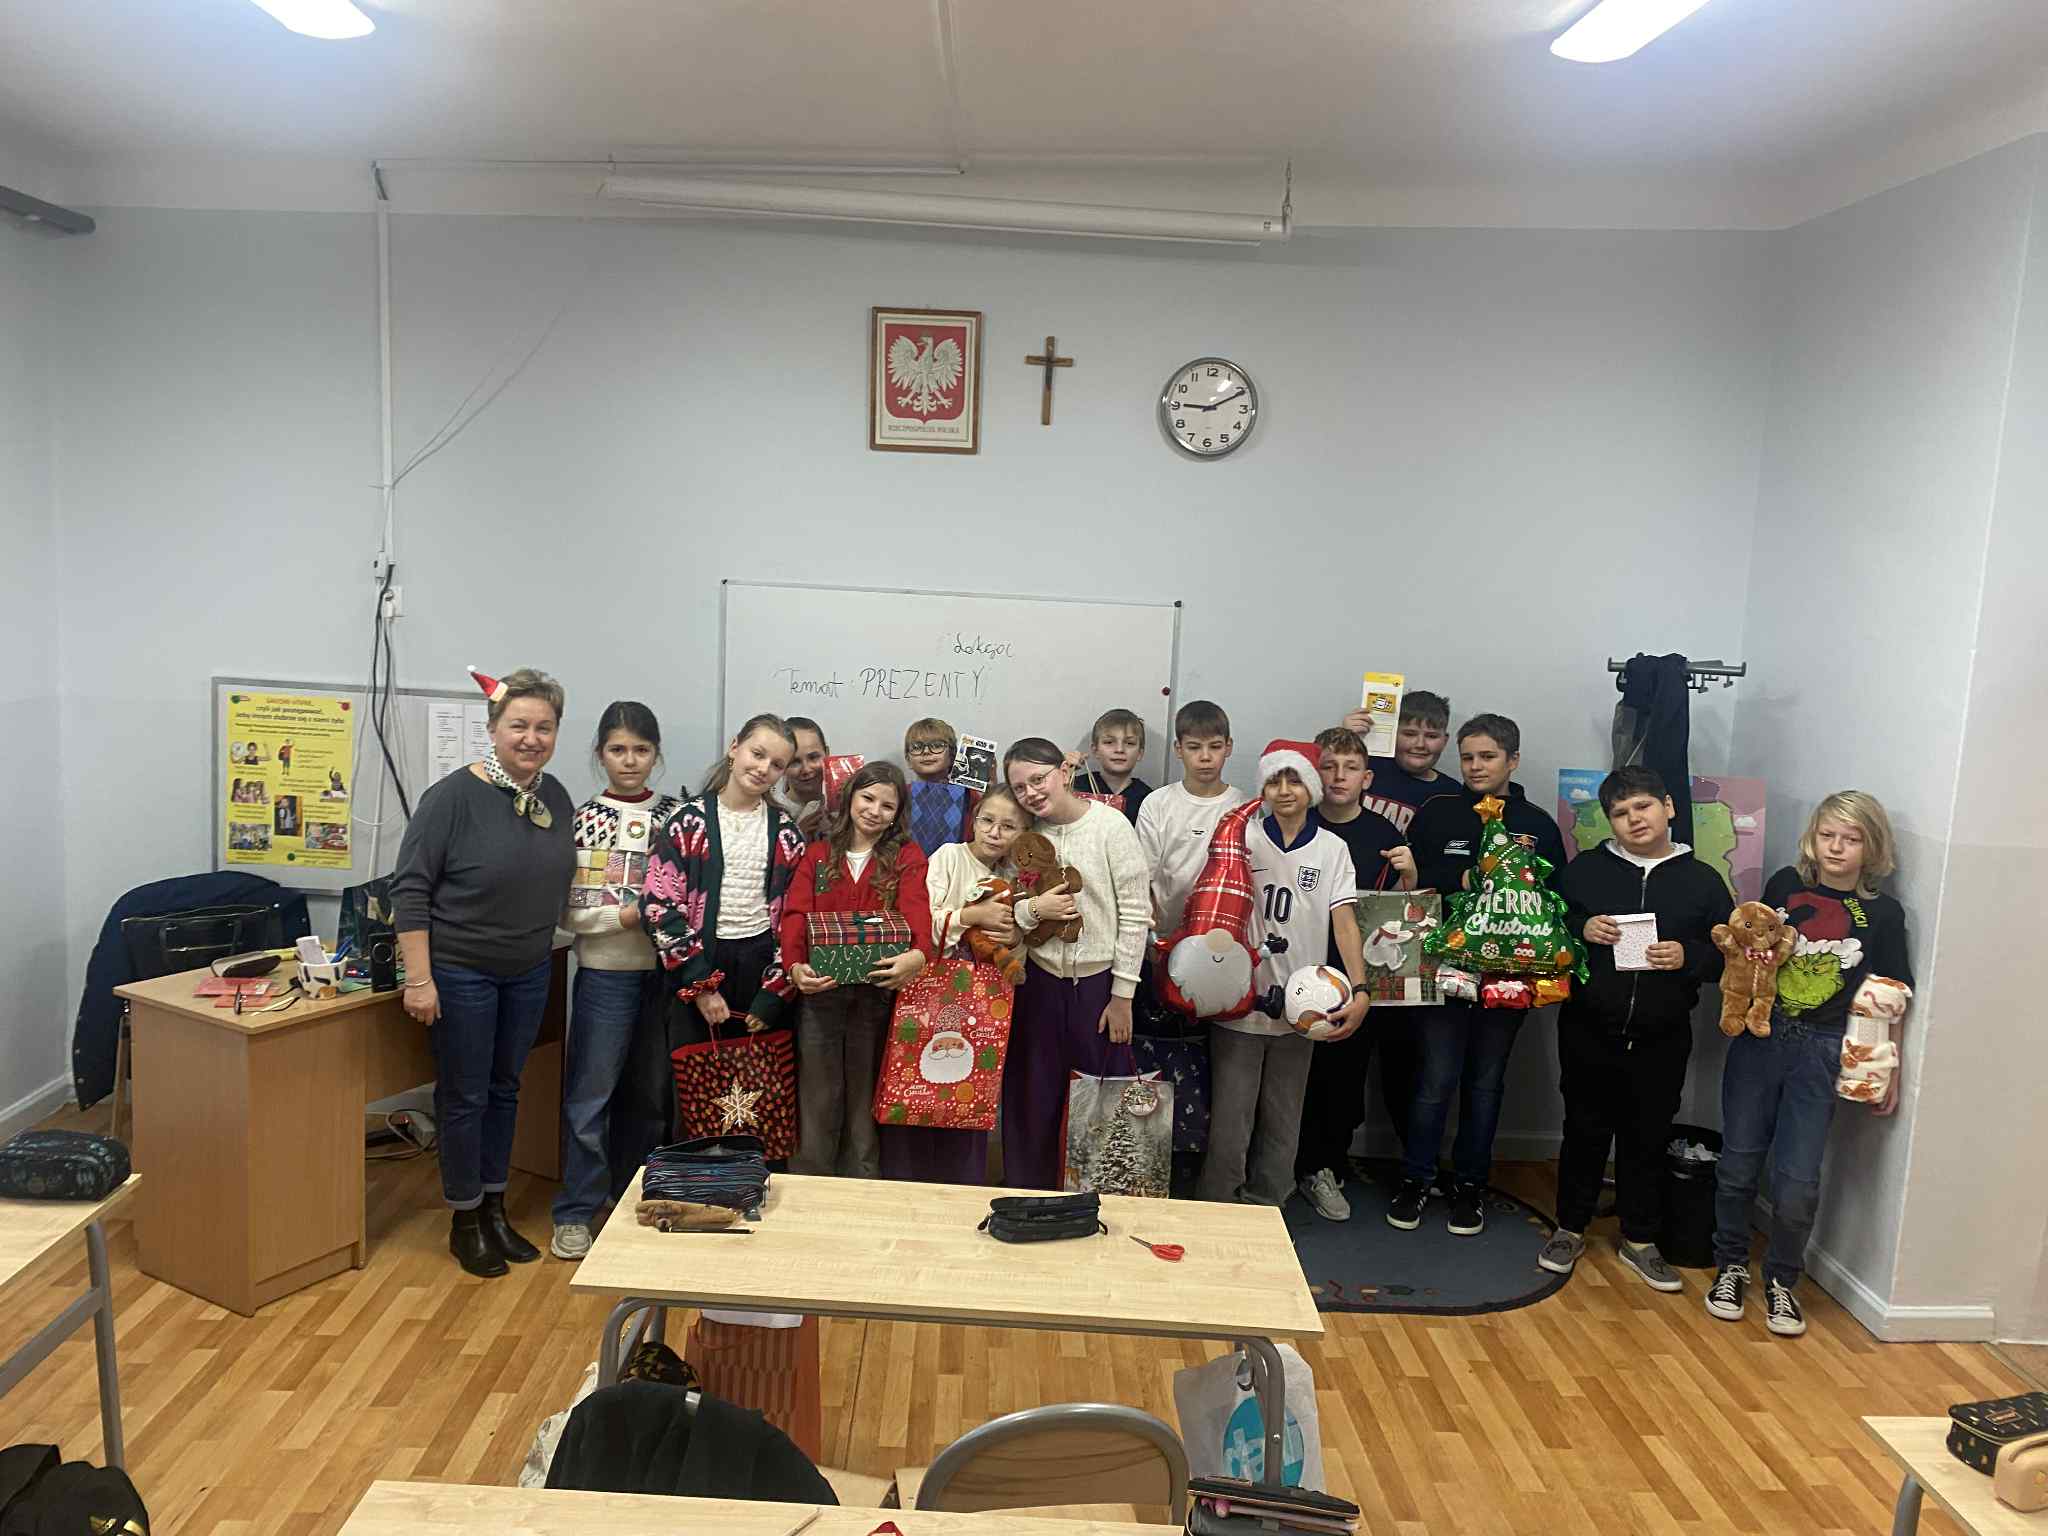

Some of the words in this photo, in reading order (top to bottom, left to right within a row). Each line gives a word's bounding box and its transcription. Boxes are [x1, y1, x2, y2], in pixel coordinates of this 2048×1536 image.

[1191, 372, 1199, 382] 11
[1206, 367, 1219, 377] 12
[1227, 372, 1232, 381] 1
[1178, 383, 1188, 394] 10
[1170, 400, 1181, 411] 9
[1238, 404, 1249, 415] 3
[1175, 419, 1186, 429] 8
[1232, 420, 1242, 431] 4
[1186, 432, 1196, 443] 7
[1202, 437, 1213, 448] 6
[1219, 433, 1230, 443] 5
[859, 665, 986, 699] PREZENTY
[1263, 883, 1293, 924] 10
[1475, 886, 1542, 916] MERRY
[1464, 912, 1554, 937] Christmas
